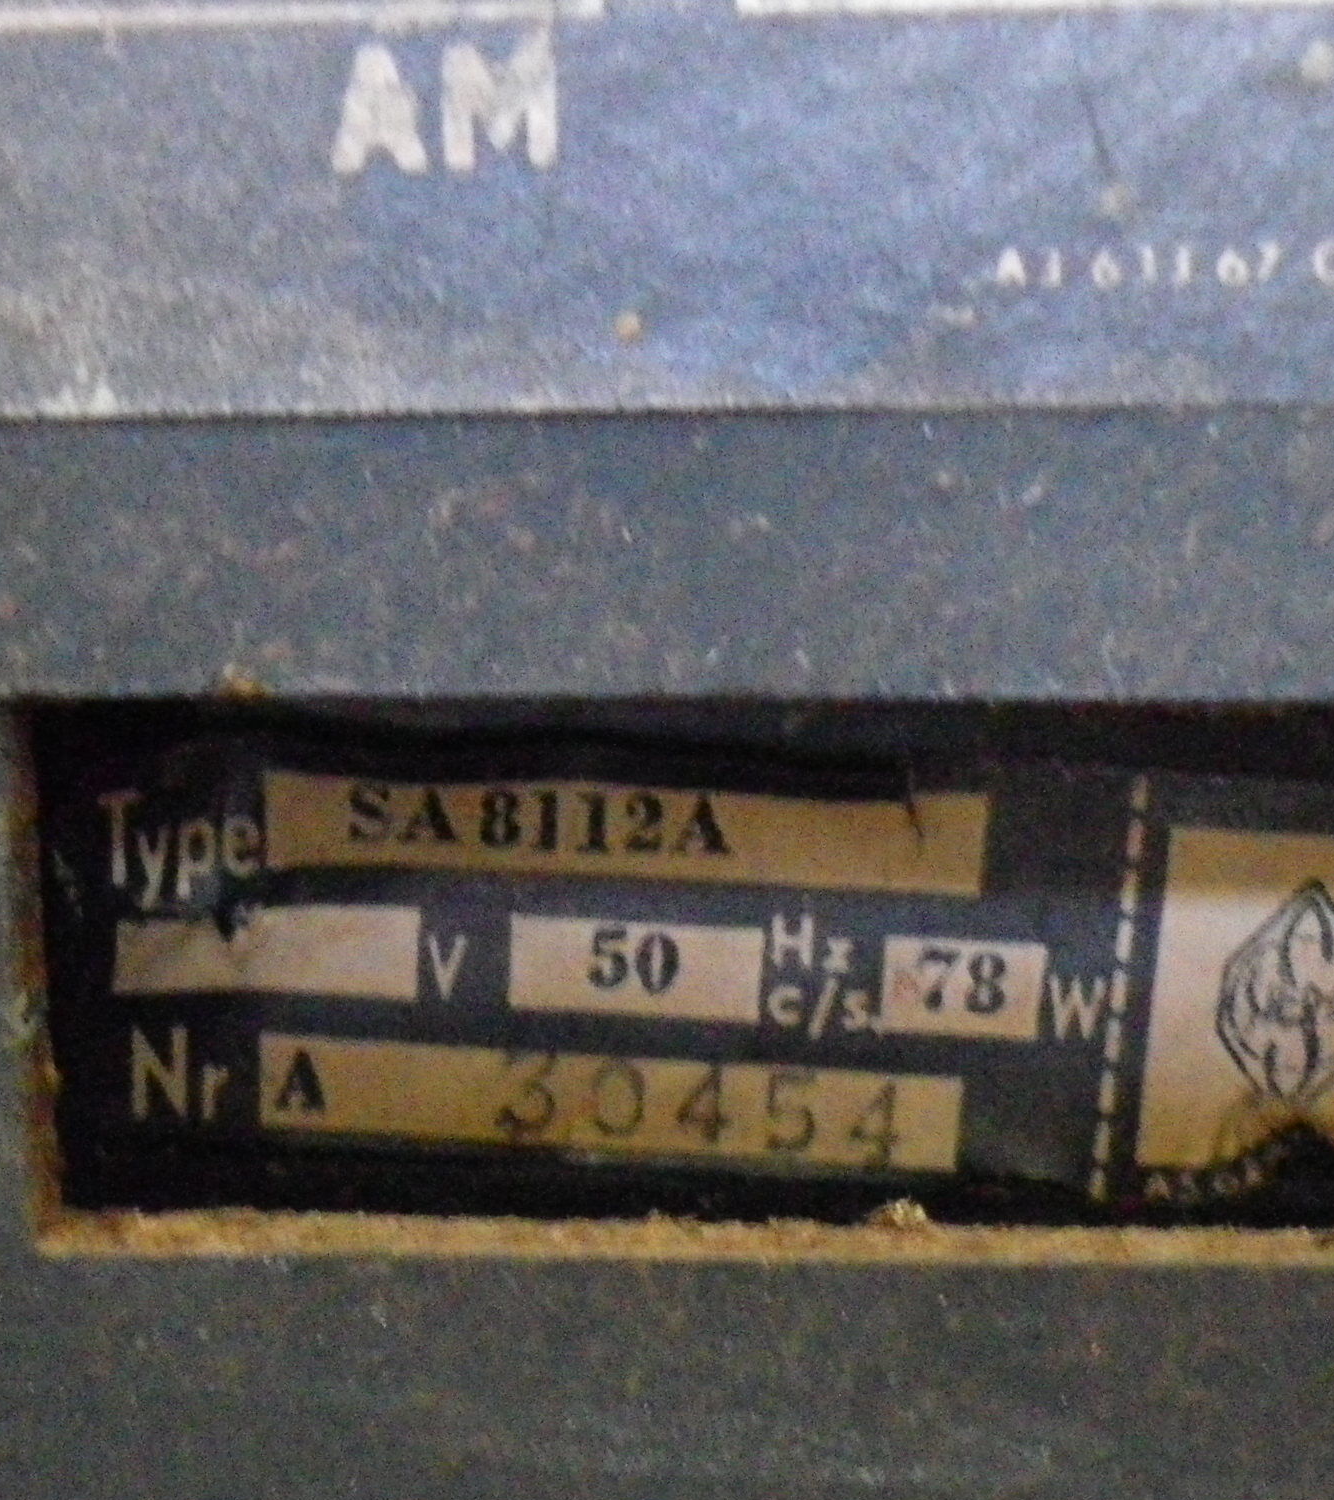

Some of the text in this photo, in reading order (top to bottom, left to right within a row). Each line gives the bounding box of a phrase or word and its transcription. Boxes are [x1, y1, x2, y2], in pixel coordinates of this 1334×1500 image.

[331, 32, 559, 174] AM
[97, 790, 264, 912] Type
[587, 924, 681, 996] 50
[914, 943, 1008, 1017] 78
[1047, 972, 1110, 1042] W
[130, 1024, 229, 1122] Nr
[275, 1048, 329, 1112] A
